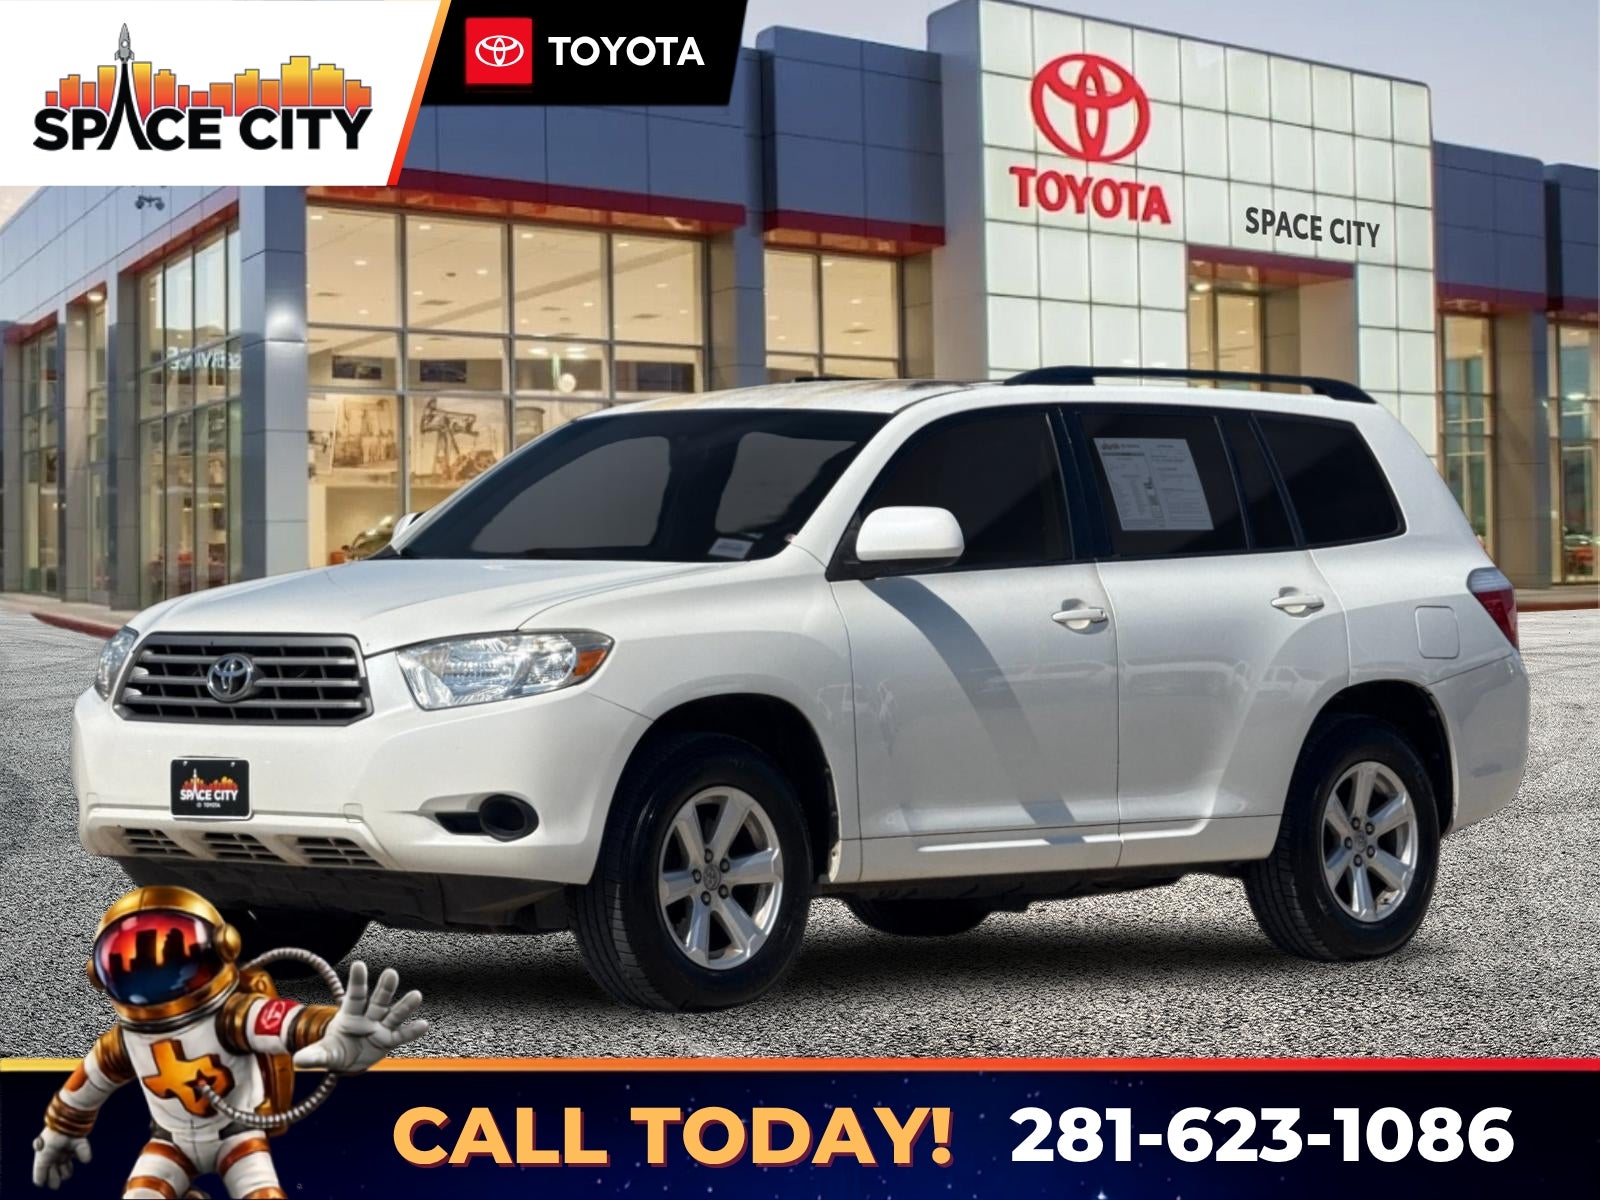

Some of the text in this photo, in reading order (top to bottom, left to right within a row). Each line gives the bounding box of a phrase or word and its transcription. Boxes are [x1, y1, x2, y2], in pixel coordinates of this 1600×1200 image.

[1009, 166, 1171, 225] TOYOTA
[1245, 206, 1381, 248] SPACE CITY
[180, 788, 239, 801] SPACE CITY
